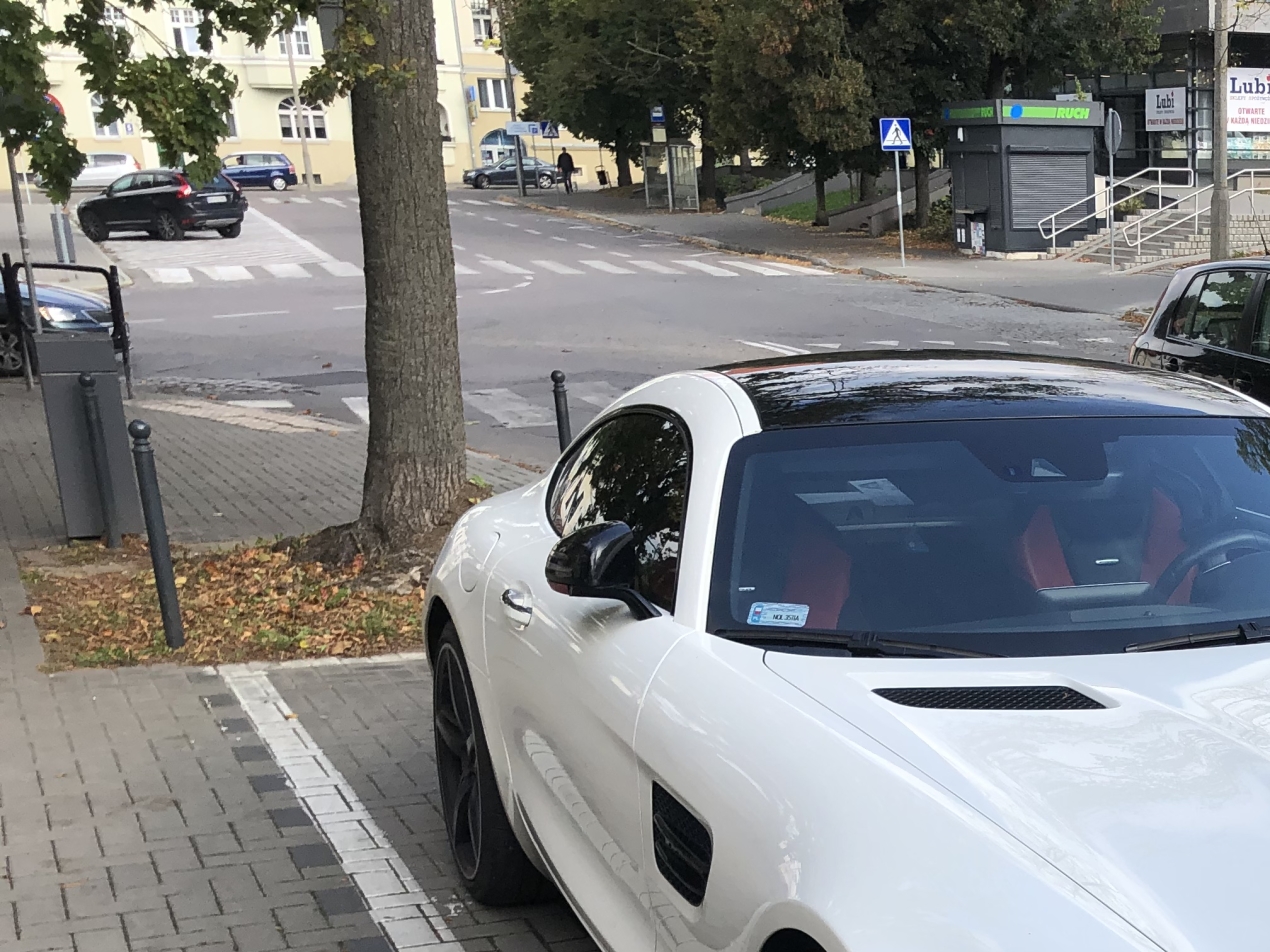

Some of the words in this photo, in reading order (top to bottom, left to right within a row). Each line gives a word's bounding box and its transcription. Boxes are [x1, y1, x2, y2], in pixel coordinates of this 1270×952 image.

[1156, 91, 1175, 109] Lubi
[1056, 107, 1090, 119] RUCH
[1238, 107, 1265, 115] OTWARTE
[1230, 116, 1249, 126] KAŻDĄ
